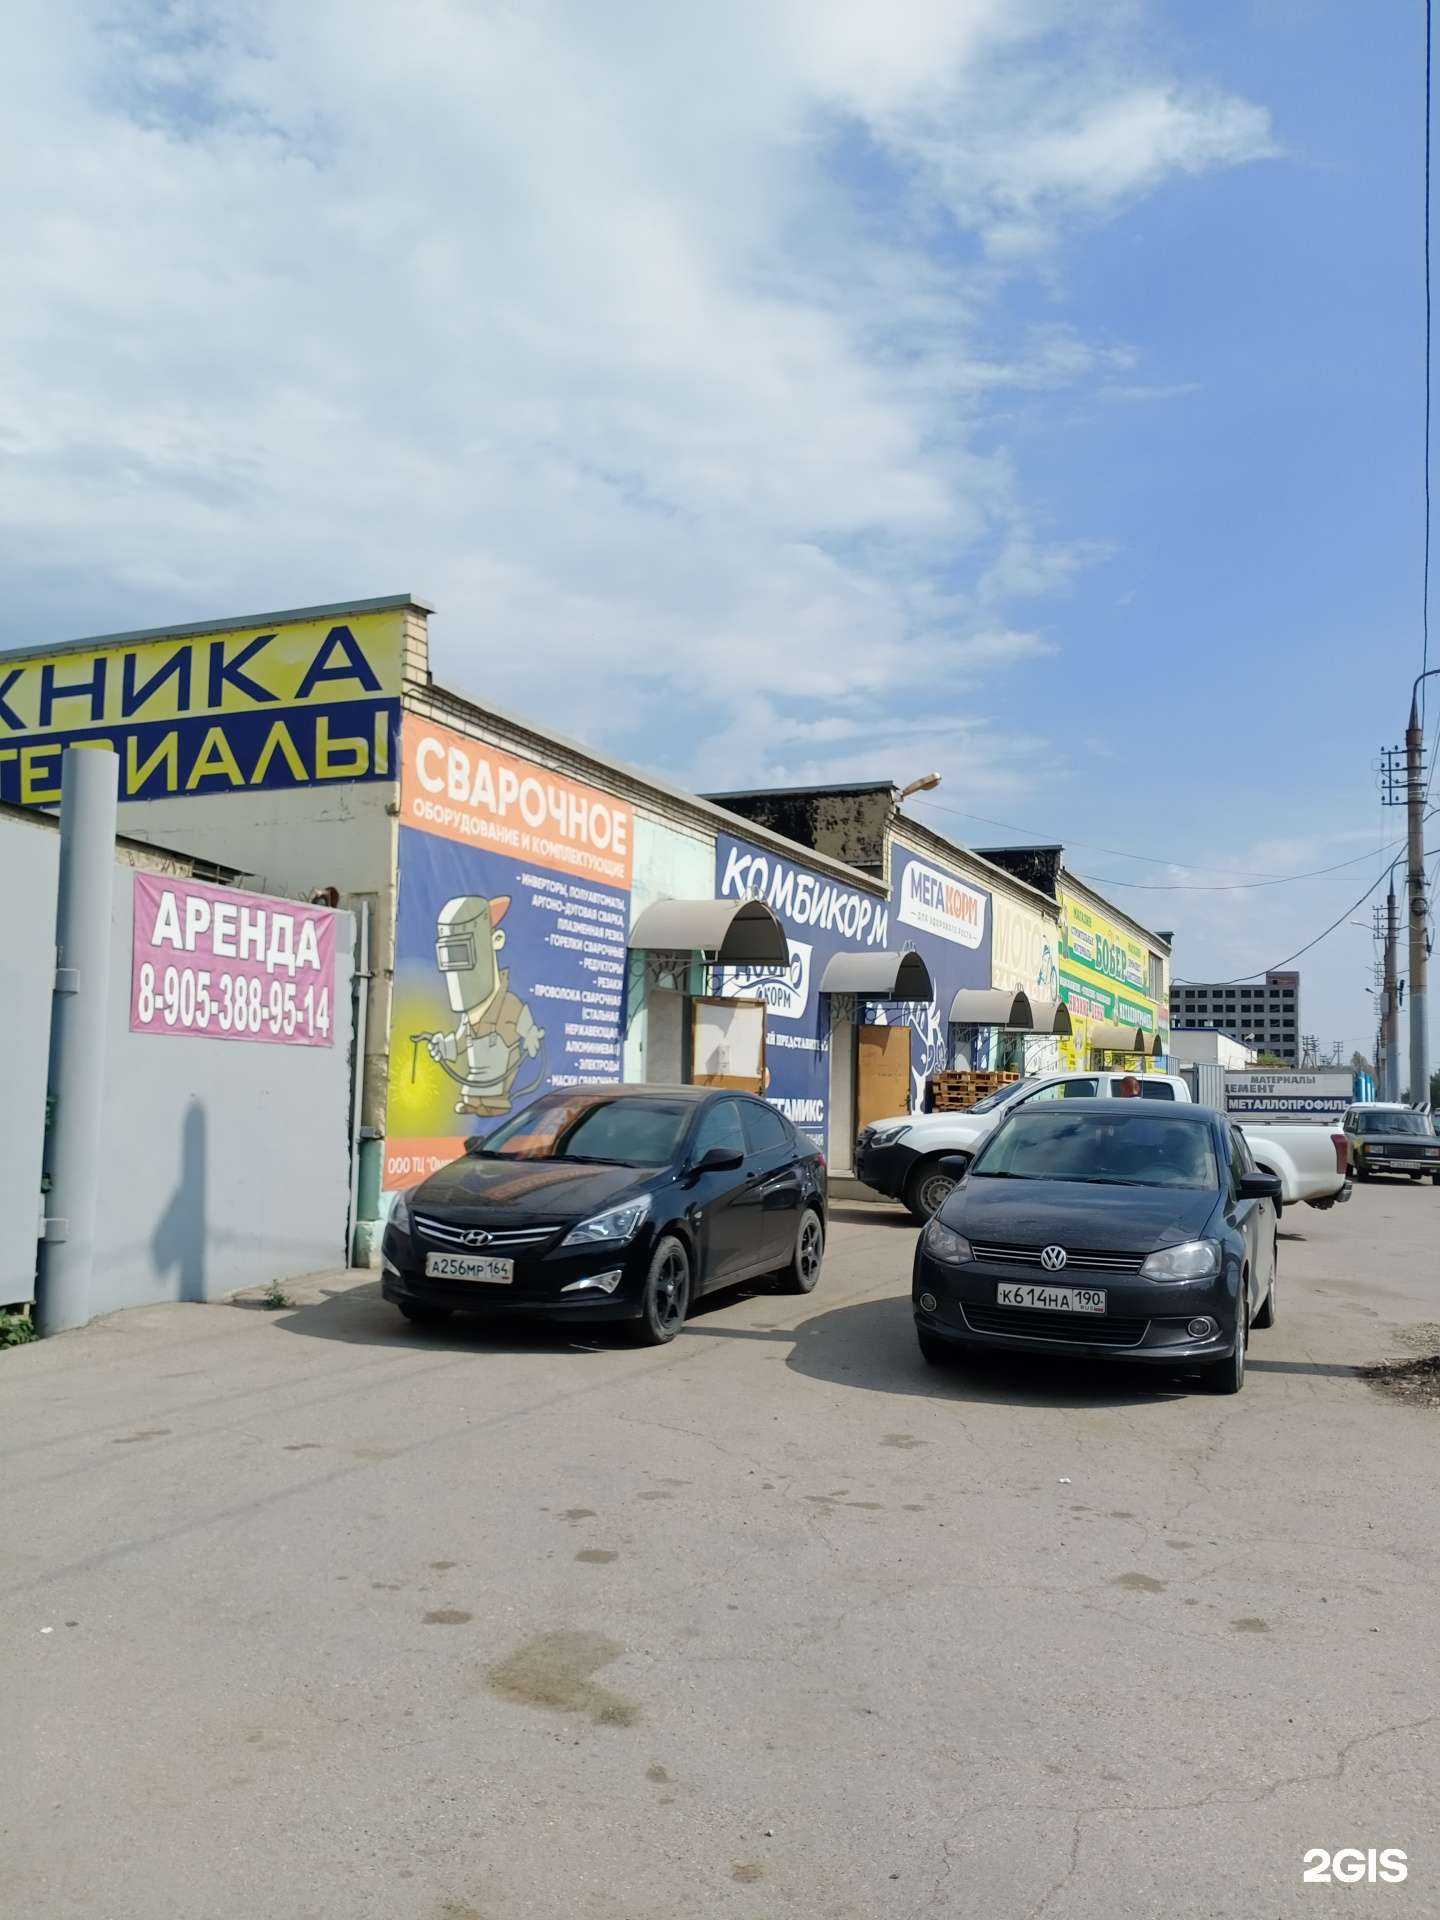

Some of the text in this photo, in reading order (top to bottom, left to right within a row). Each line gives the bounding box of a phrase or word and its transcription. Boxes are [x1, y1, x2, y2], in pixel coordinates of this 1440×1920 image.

[0, 710, 389, 804] ЕИАЛЫ
[416, 737, 627, 855] СВАРОЧНОЕ
[413, 798, 624, 879] ОБОРУДОВАНИЕ И КОМПЛЕКТУЮЩИЕ
[151, 891, 320, 977] АРЕНДА
[721, 847, 888, 949] КОМБИКОРМ
[138, 962, 330, 1038] 8-905-388-95-14
[1228, 1099, 1350, 1110] МЕТАЛЛОПРОФИЛЬ
[1250, 1076, 1316, 1084] МАТЕРИАЛЫ
[388, 1156, 410, 1174] ООО
[1075, 1291, 1101, 1306] 190
